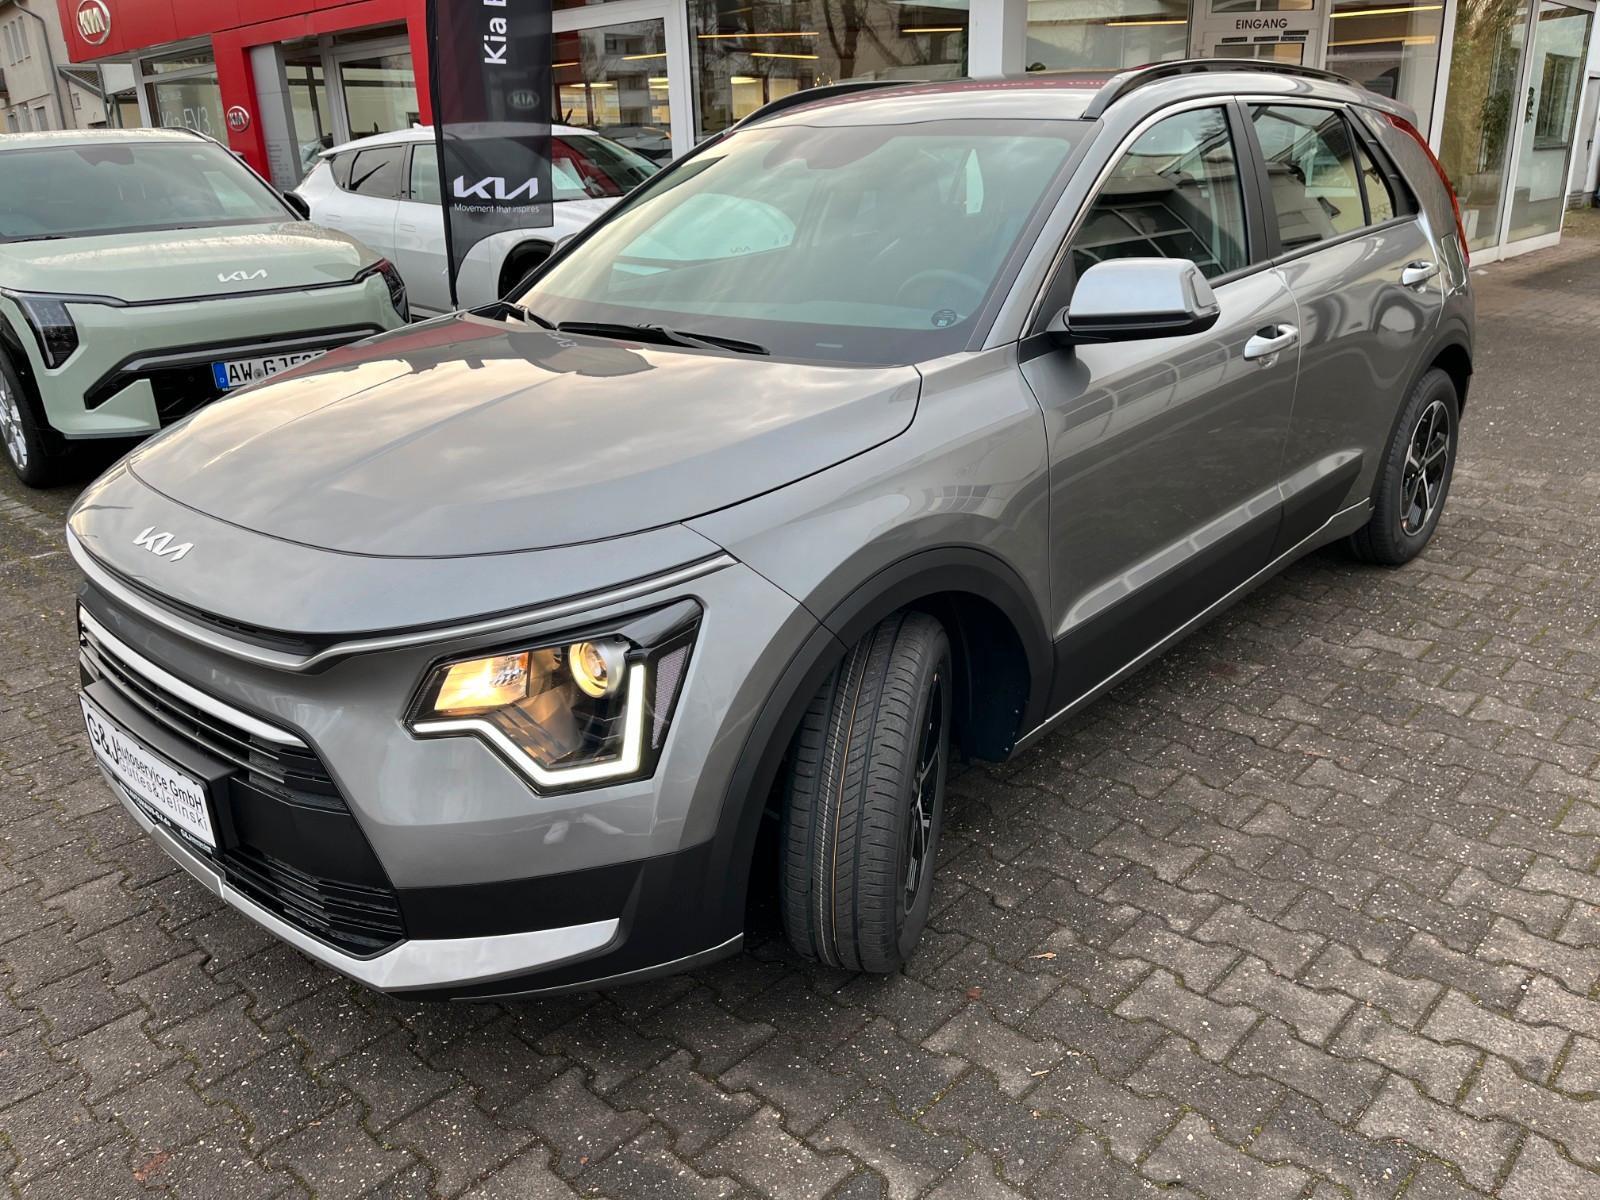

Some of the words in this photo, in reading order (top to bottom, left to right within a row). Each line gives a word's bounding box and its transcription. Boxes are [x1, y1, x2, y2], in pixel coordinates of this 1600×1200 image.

[78, 7, 106, 36] KIA
[1235, 18, 1288, 30] EINGANG
[483, 17, 507, 65] Kia
[228, 111, 246, 126] KIA
[453, 175, 539, 200] KIA
[454, 203, 494, 213] Movement
[496, 205, 511, 213] that
[513, 205, 540, 214] inspires
[217, 269, 268, 282] KIA
[229, 362, 253, 384] AW
[132, 526, 195, 563] KIA
[87, 713, 120, 765] G&J
[116, 739, 168, 790] Autoservice
[169, 779, 204, 815] GmbH
